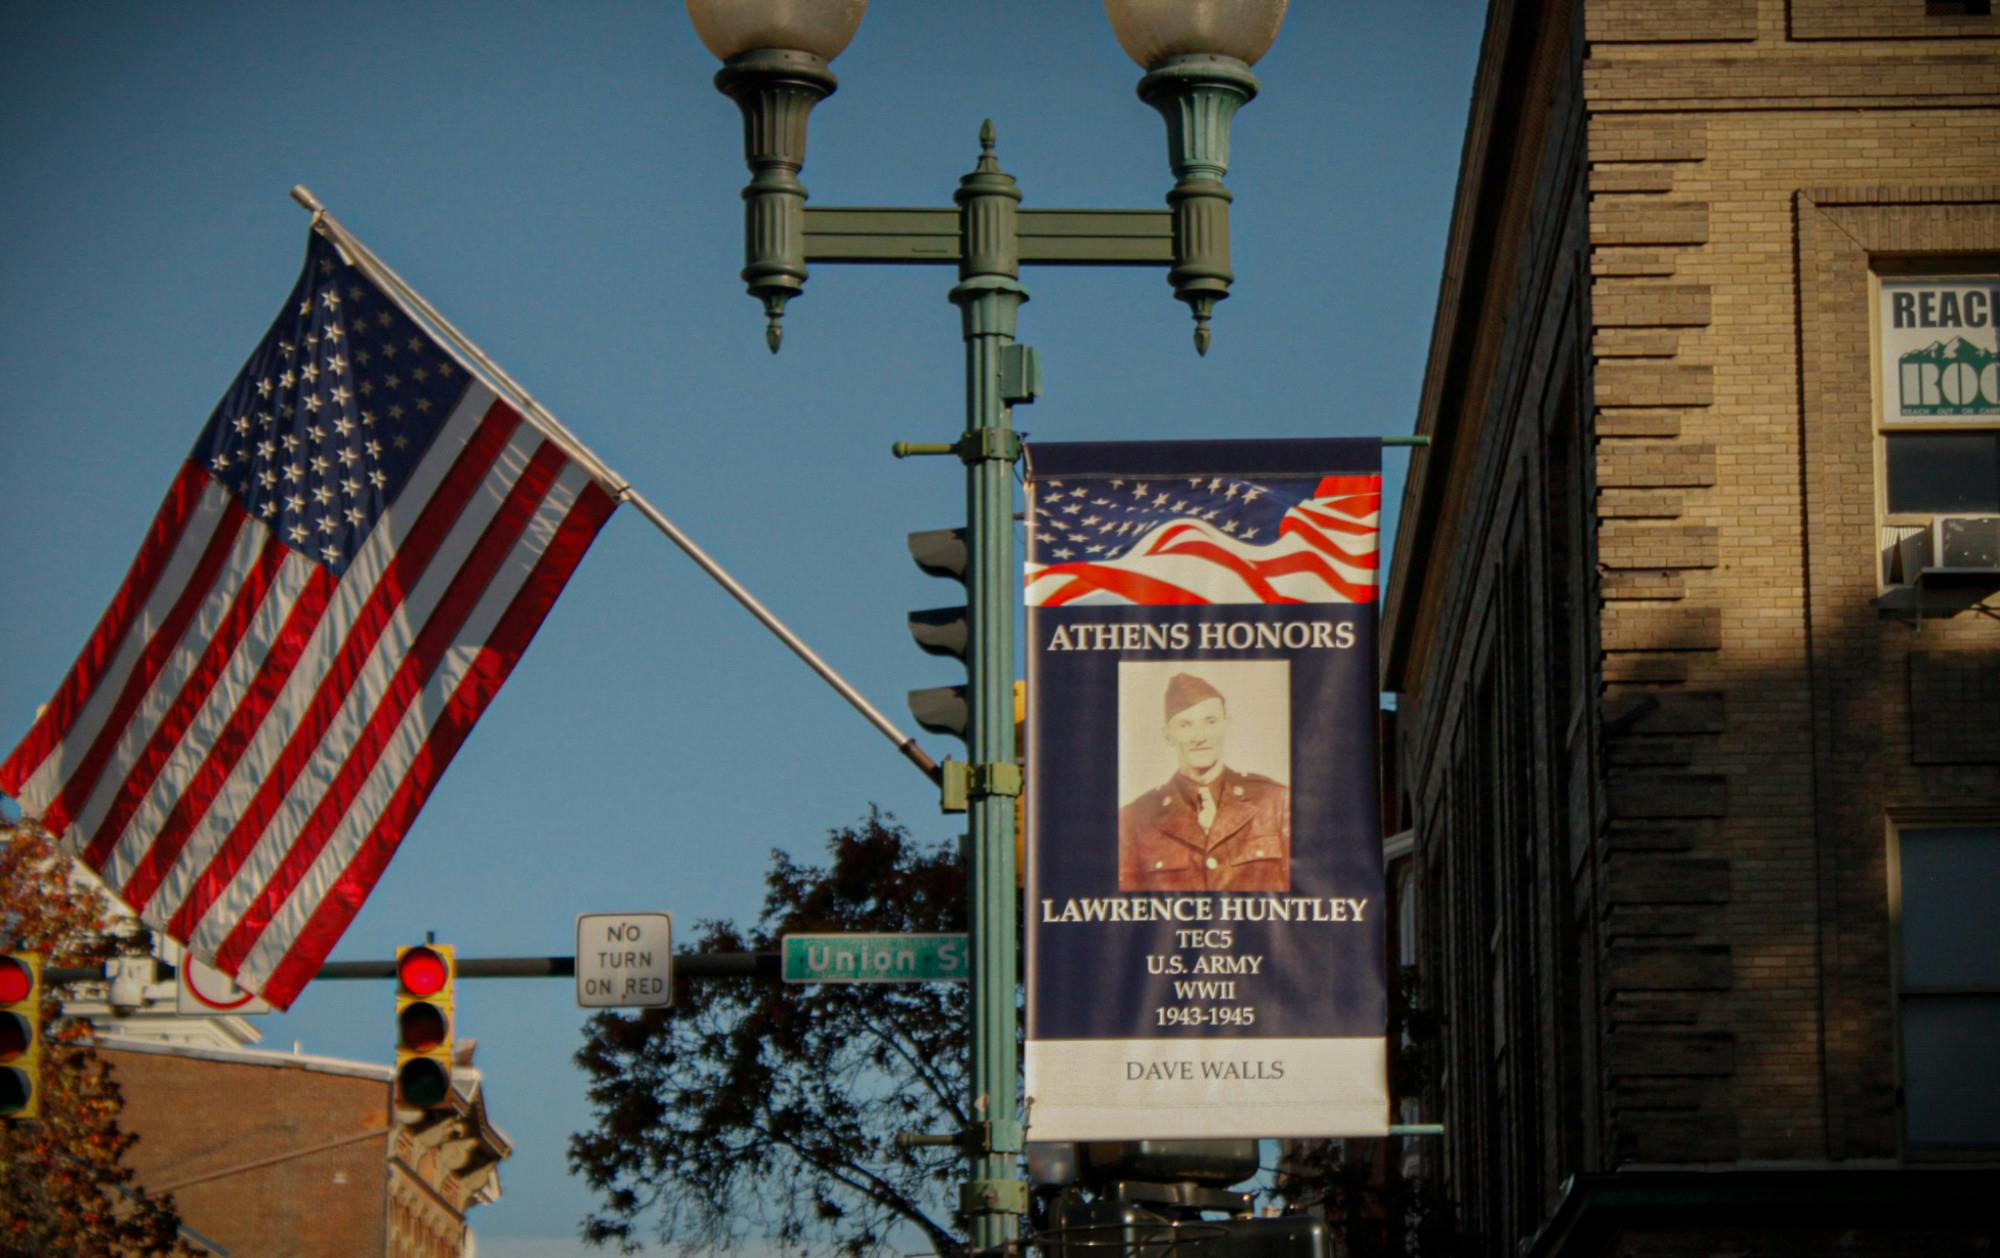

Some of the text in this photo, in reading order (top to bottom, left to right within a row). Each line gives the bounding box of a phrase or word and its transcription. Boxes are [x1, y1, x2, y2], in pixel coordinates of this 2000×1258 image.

[1048, 621, 1356, 650] ATHENS HONORS
[1042, 897, 1367, 922] LAWRENCE HUNTLEY
[607, 925, 640, 942] NO
[1176, 929, 1232, 949] TEC5
[597, 952, 652, 969] TURN
[807, 946, 915, 971] Union
[1146, 955, 1263, 975] U.S. ARMY
[585, 978, 663, 996] ON RED
[1174, 981, 1235, 1000] WWII
[1156, 1007, 1255, 1026] 1943-1945
[1126, 1060, 1284, 1080] DAVE WALLS
